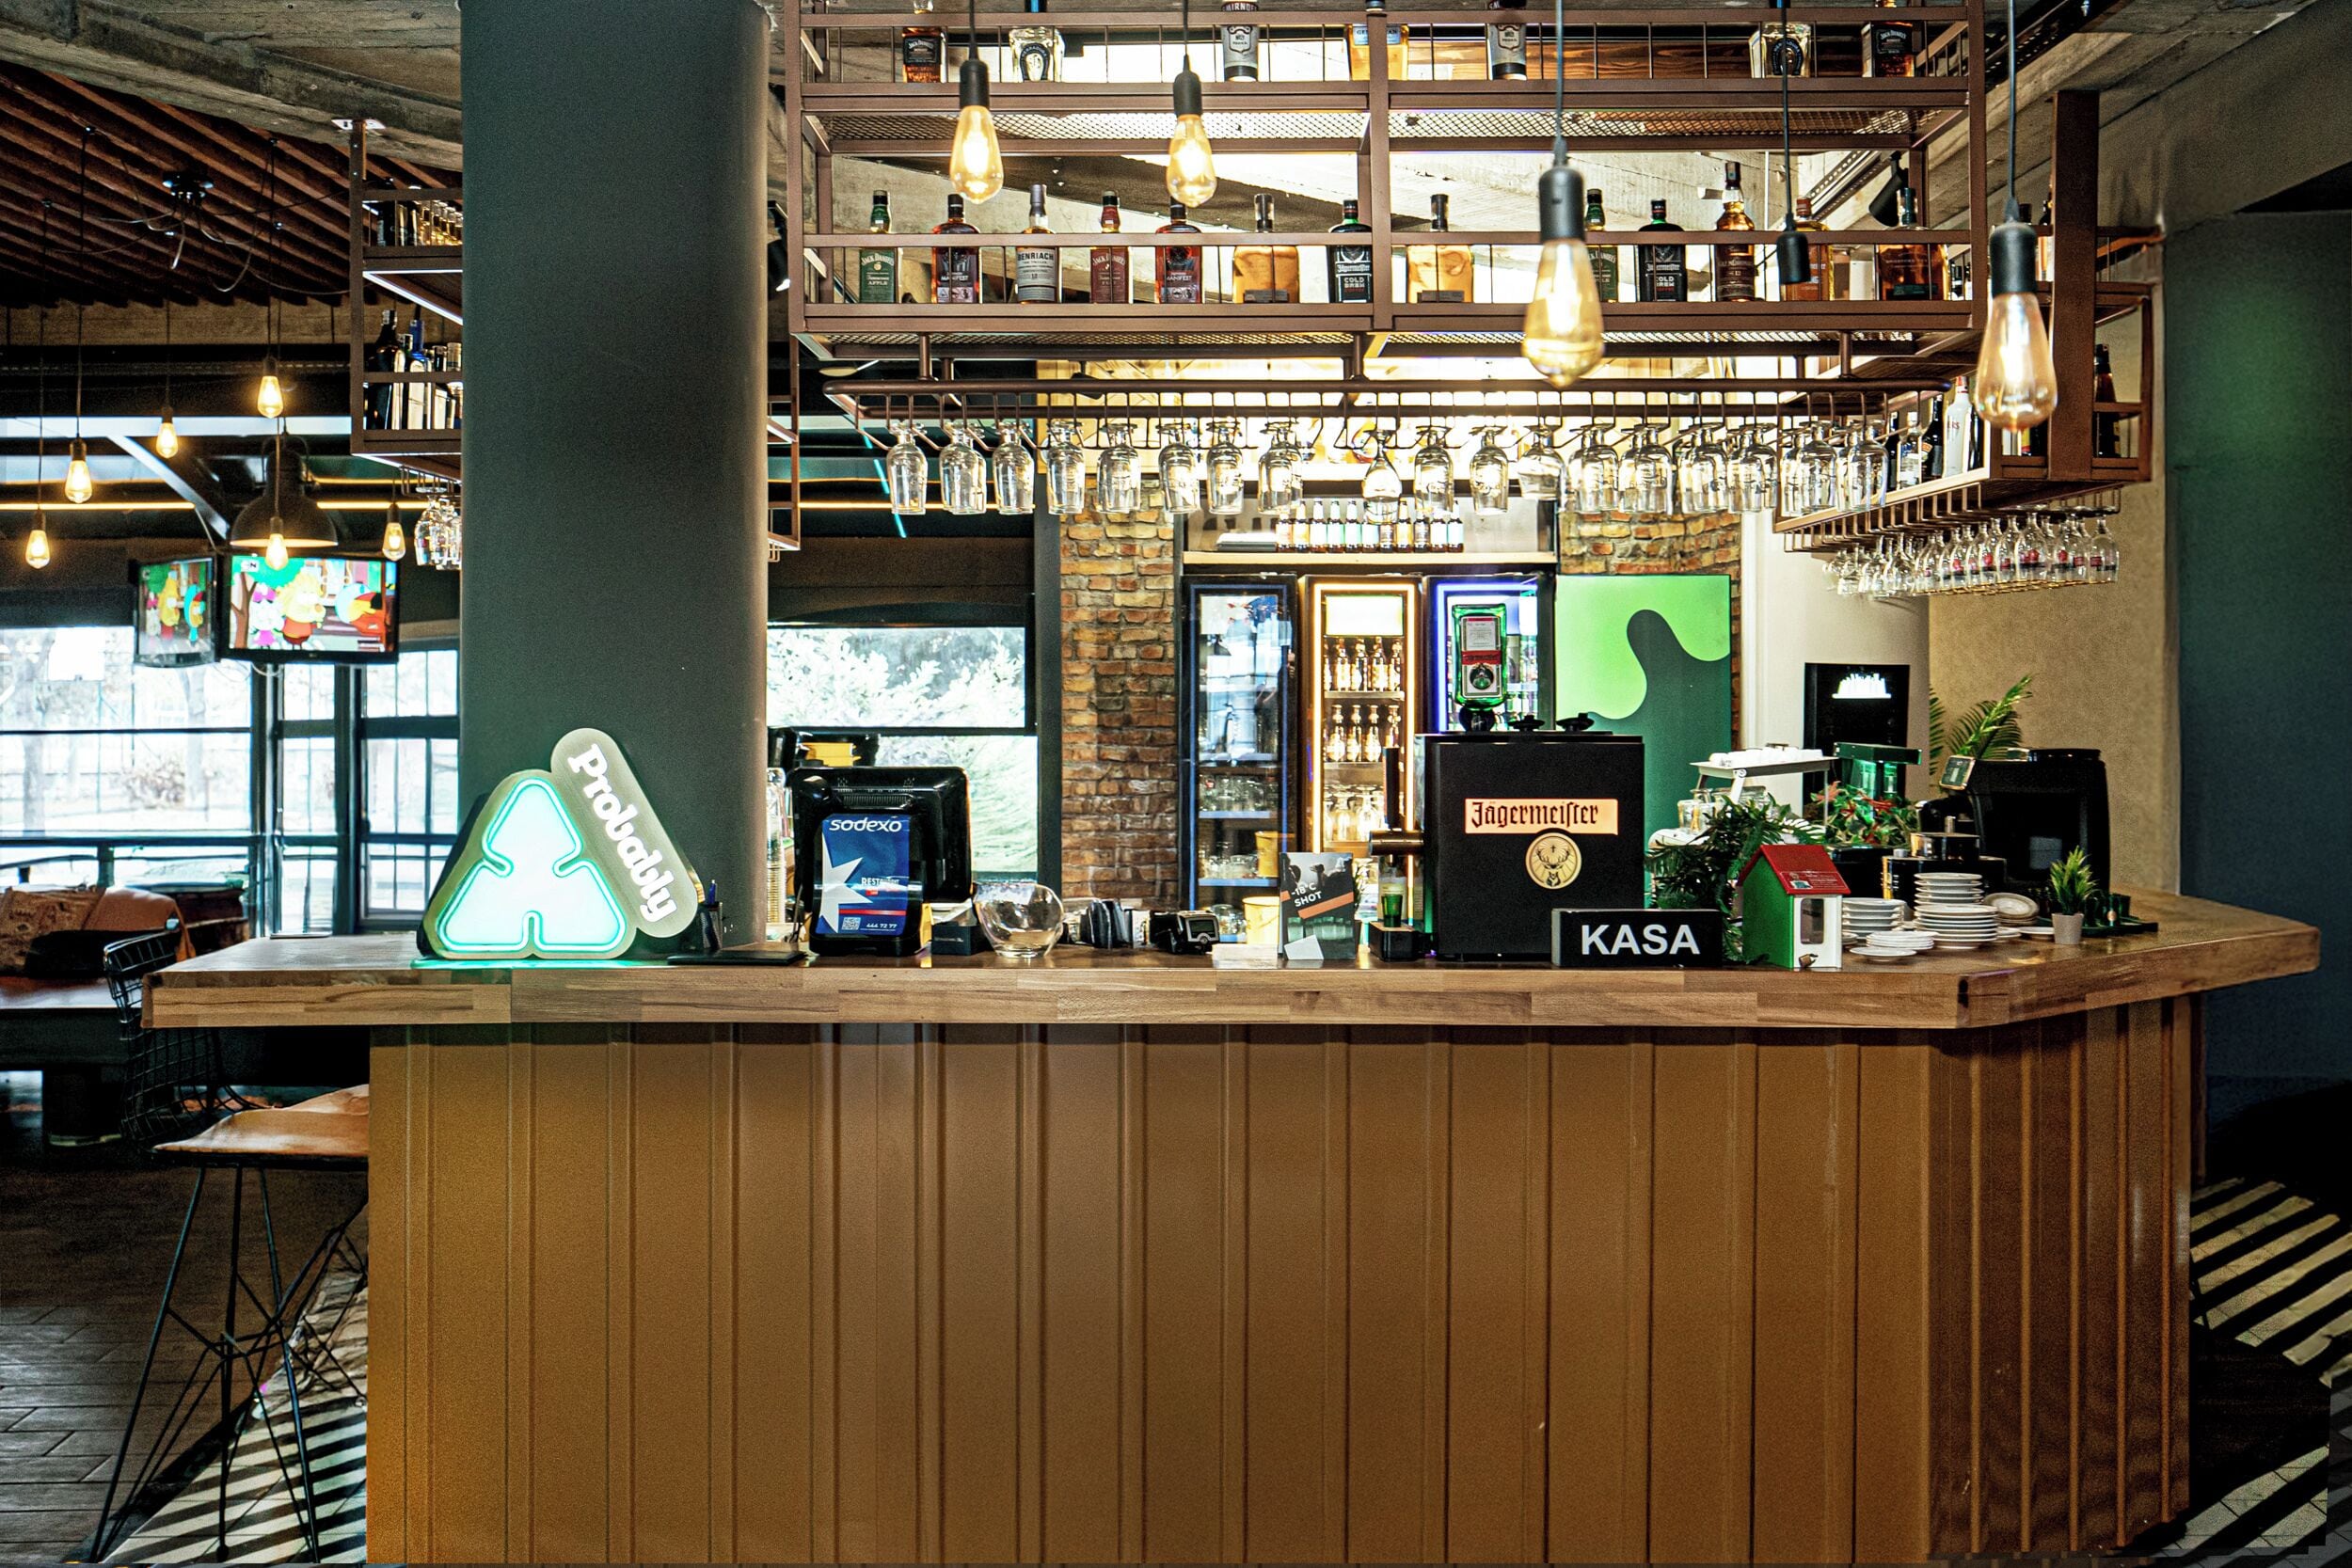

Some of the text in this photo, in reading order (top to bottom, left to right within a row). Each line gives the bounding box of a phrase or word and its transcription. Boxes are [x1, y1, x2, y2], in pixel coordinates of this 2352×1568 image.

[1018, 252, 1054, 261] BENRIACH
[828, 816, 902, 832] sodexo
[567, 743, 677, 923] Probably
[1294, 891, 1322, 908] SHOT
[1581, 924, 1701, 955] KASA
